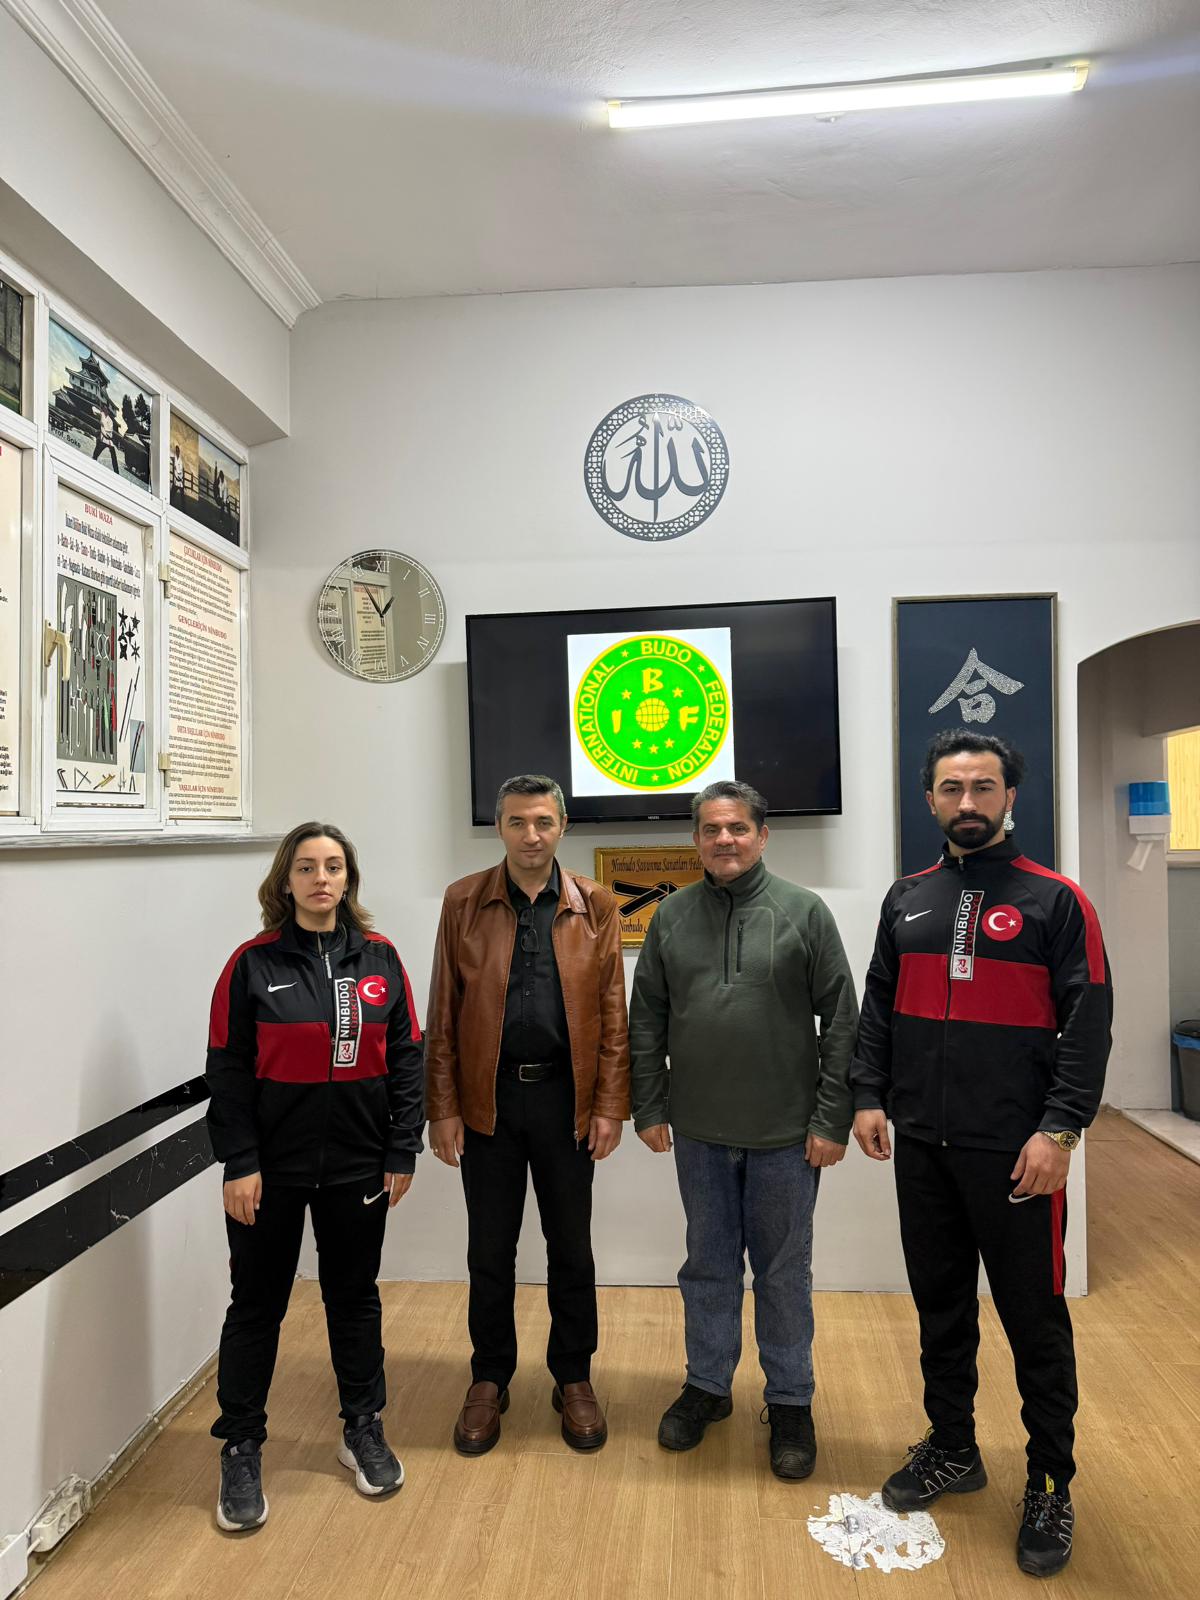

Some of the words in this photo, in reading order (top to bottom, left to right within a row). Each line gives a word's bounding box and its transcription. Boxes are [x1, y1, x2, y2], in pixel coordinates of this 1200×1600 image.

[98, 510, 113, 525] WAZA
[375, 560, 389, 573] XII
[418, 587, 430, 598] II
[424, 613, 436, 624] III
[641, 667, 664, 695] B
[579, 662, 639, 783] INTERNATIONAL
[640, 640, 692, 664] BUDO
[666, 679, 725, 780] FEDERATION
[679, 705, 700, 732] F
[954, 893, 974, 954] NINBUDO
[338, 982, 351, 1038] NINBUDO
